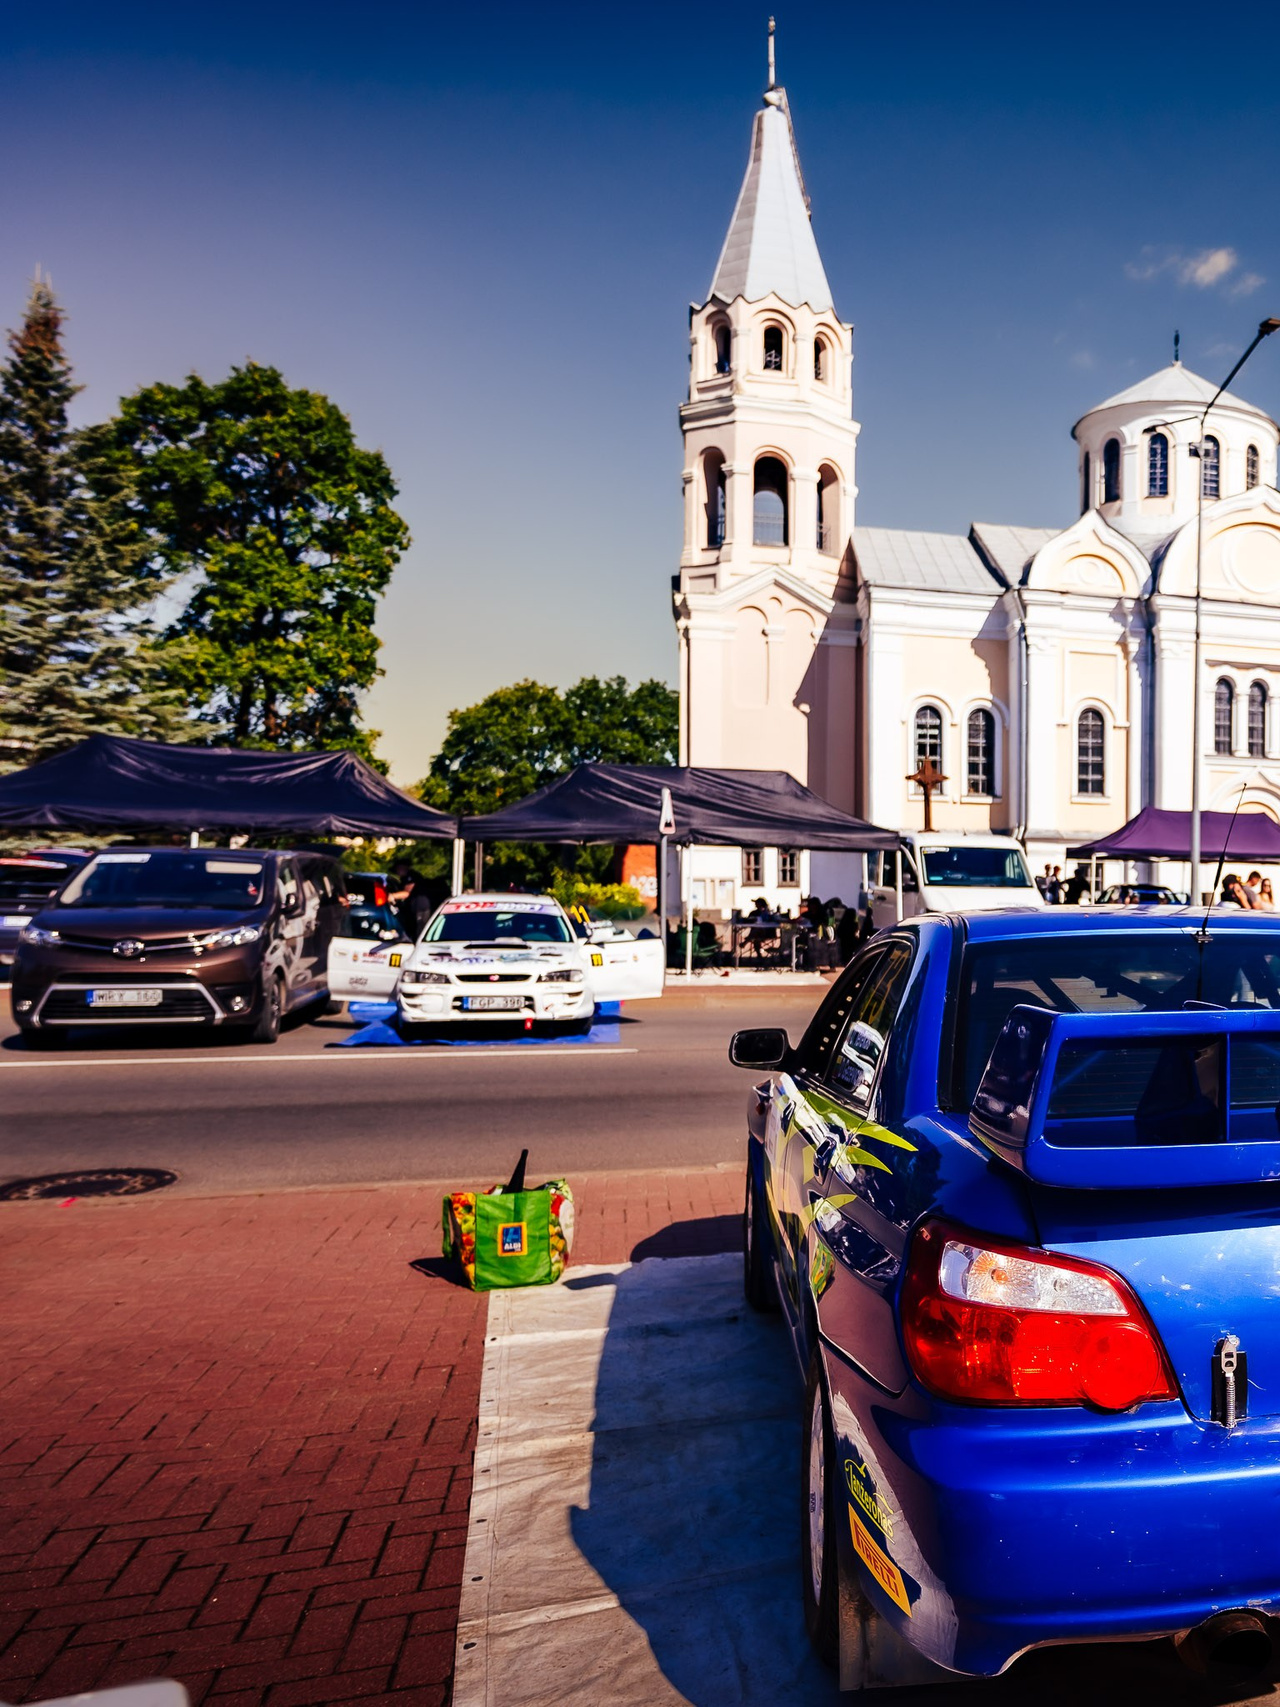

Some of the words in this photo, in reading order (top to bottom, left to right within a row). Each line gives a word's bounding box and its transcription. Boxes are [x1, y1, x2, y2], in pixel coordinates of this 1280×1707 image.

[570, 905, 591, 924] 11
[504, 1242, 521, 1250] ALDI
[853, 1519, 900, 1598] PIRELLI
